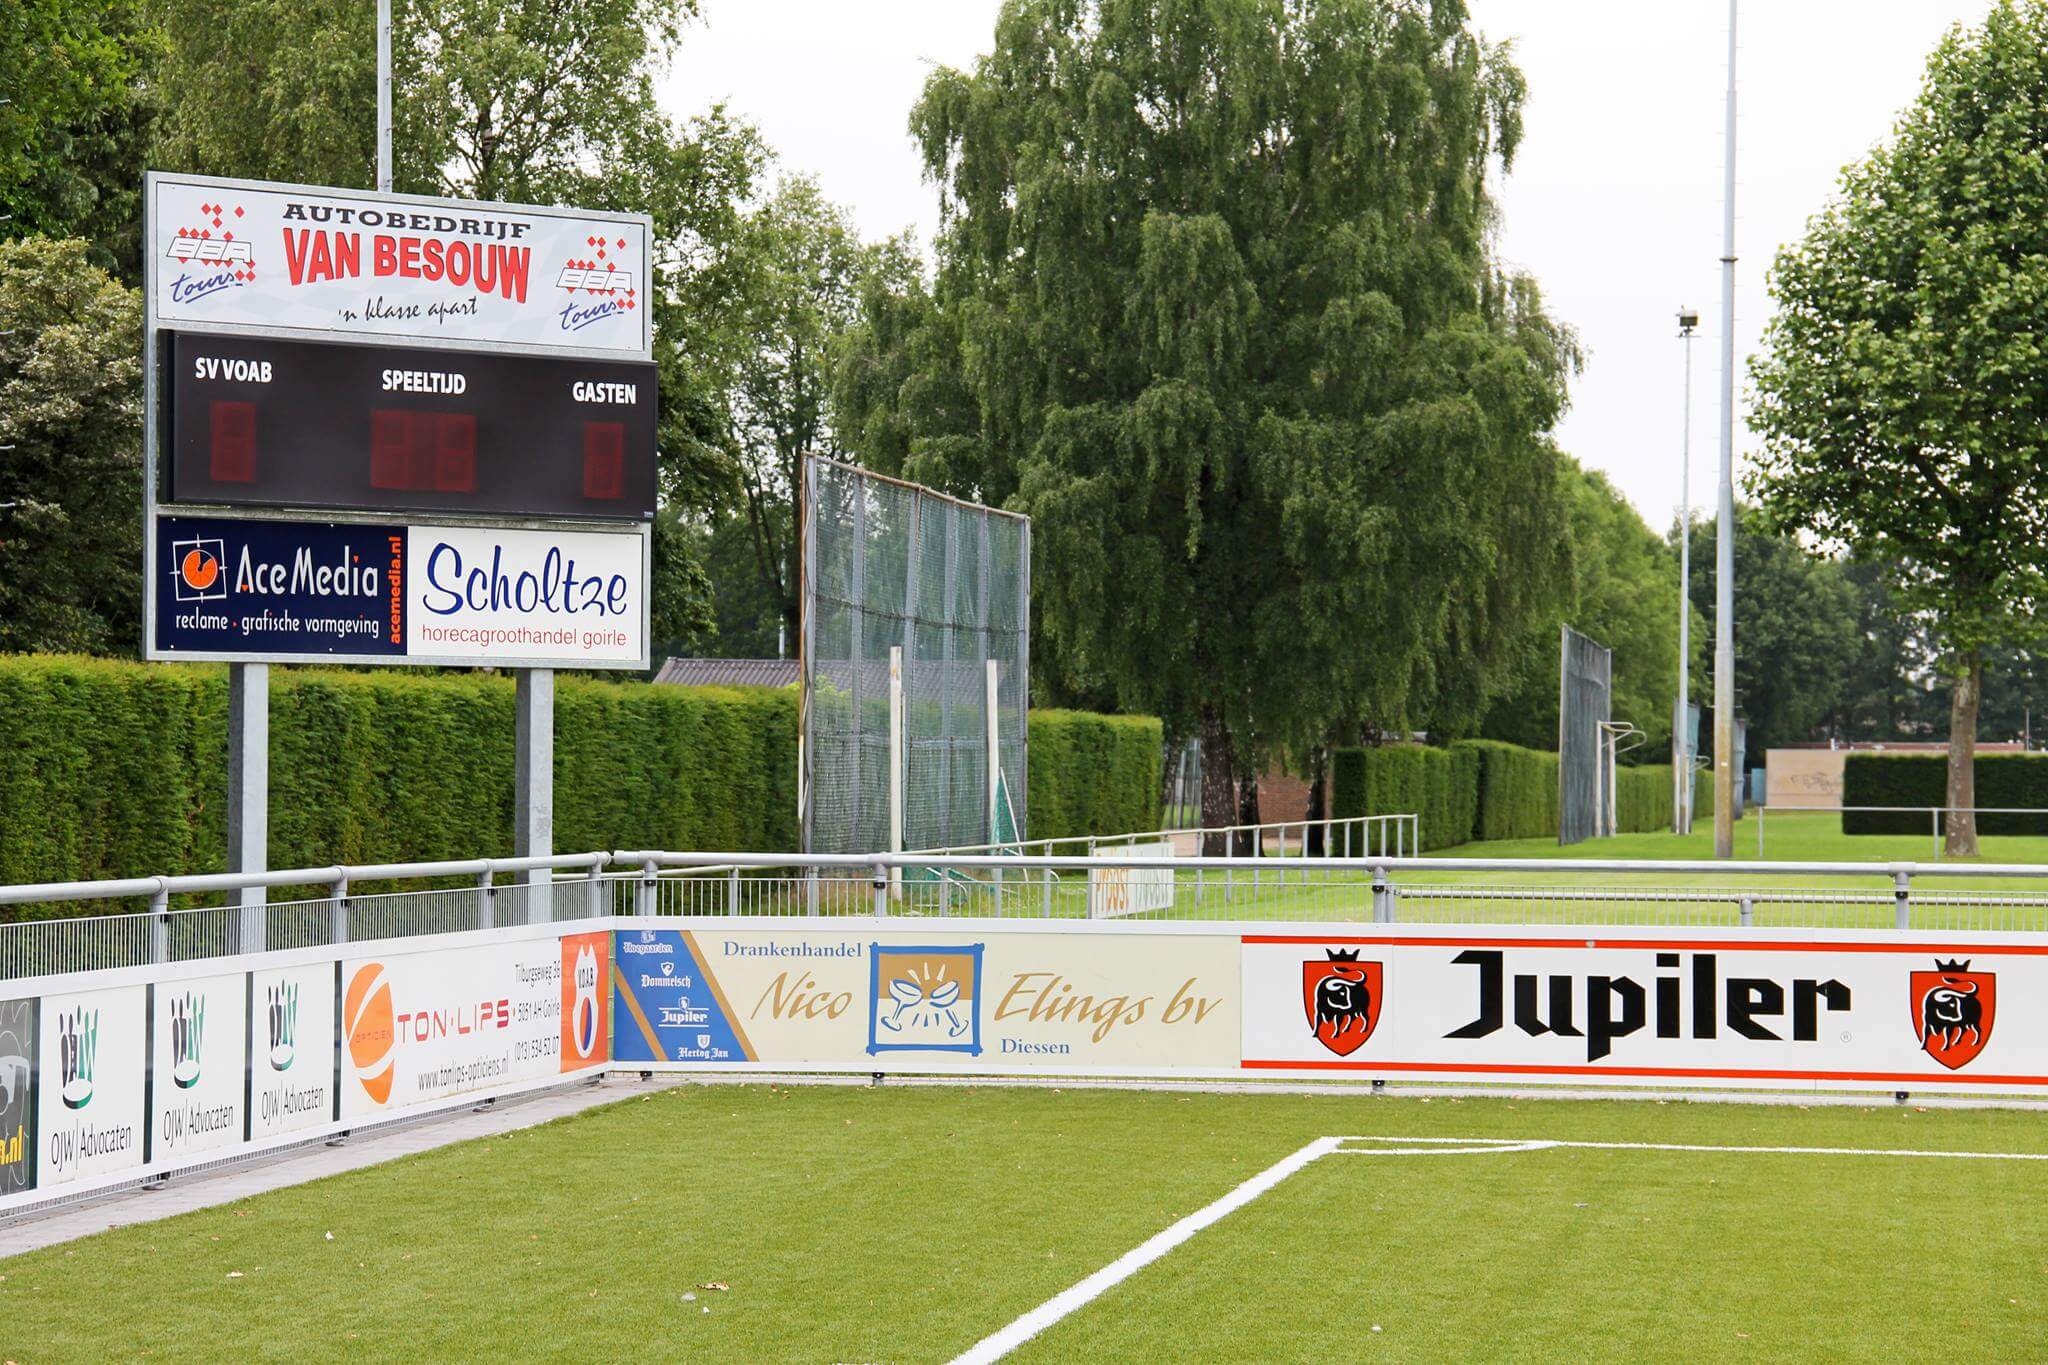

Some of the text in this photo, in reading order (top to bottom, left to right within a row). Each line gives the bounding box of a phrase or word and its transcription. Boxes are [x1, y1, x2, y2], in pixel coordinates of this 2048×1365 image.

[283, 203, 532, 240] AUTOBEDRIJF
[283, 227, 532, 305] VAN BESOUW
[170, 272, 235, 303] tours
[338, 298, 479, 326] 'n klasse apart
[560, 301, 617, 330] tours
[195, 357, 273, 384] SV VOAB
[382, 369, 466, 395] SPEELTIJD
[572, 381, 637, 405] GASTEN
[388, 536, 402, 645] acemedia.nl
[422, 542, 627, 617] Scholtze
[176, 606, 380, 639] reclame grafische vormgeving
[422, 623, 627, 649] horecagroothandel goirle
[623, 942, 673, 955] Hoegaarden
[724, 941, 862, 957] Drankenhandel
[641, 974, 691, 989] Dommelsch
[661, 1010, 708, 1024] Jupiler
[750, 970, 1223, 1044] Nico Elings bv
[1441, 949, 1852, 1063] Jupiler
[678, 1047, 729, 1060] Hertog Jan
[1001, 1038, 1070, 1055] Diessen
[417, 1050, 510, 1091] www.tonlips-opticiens.nl
